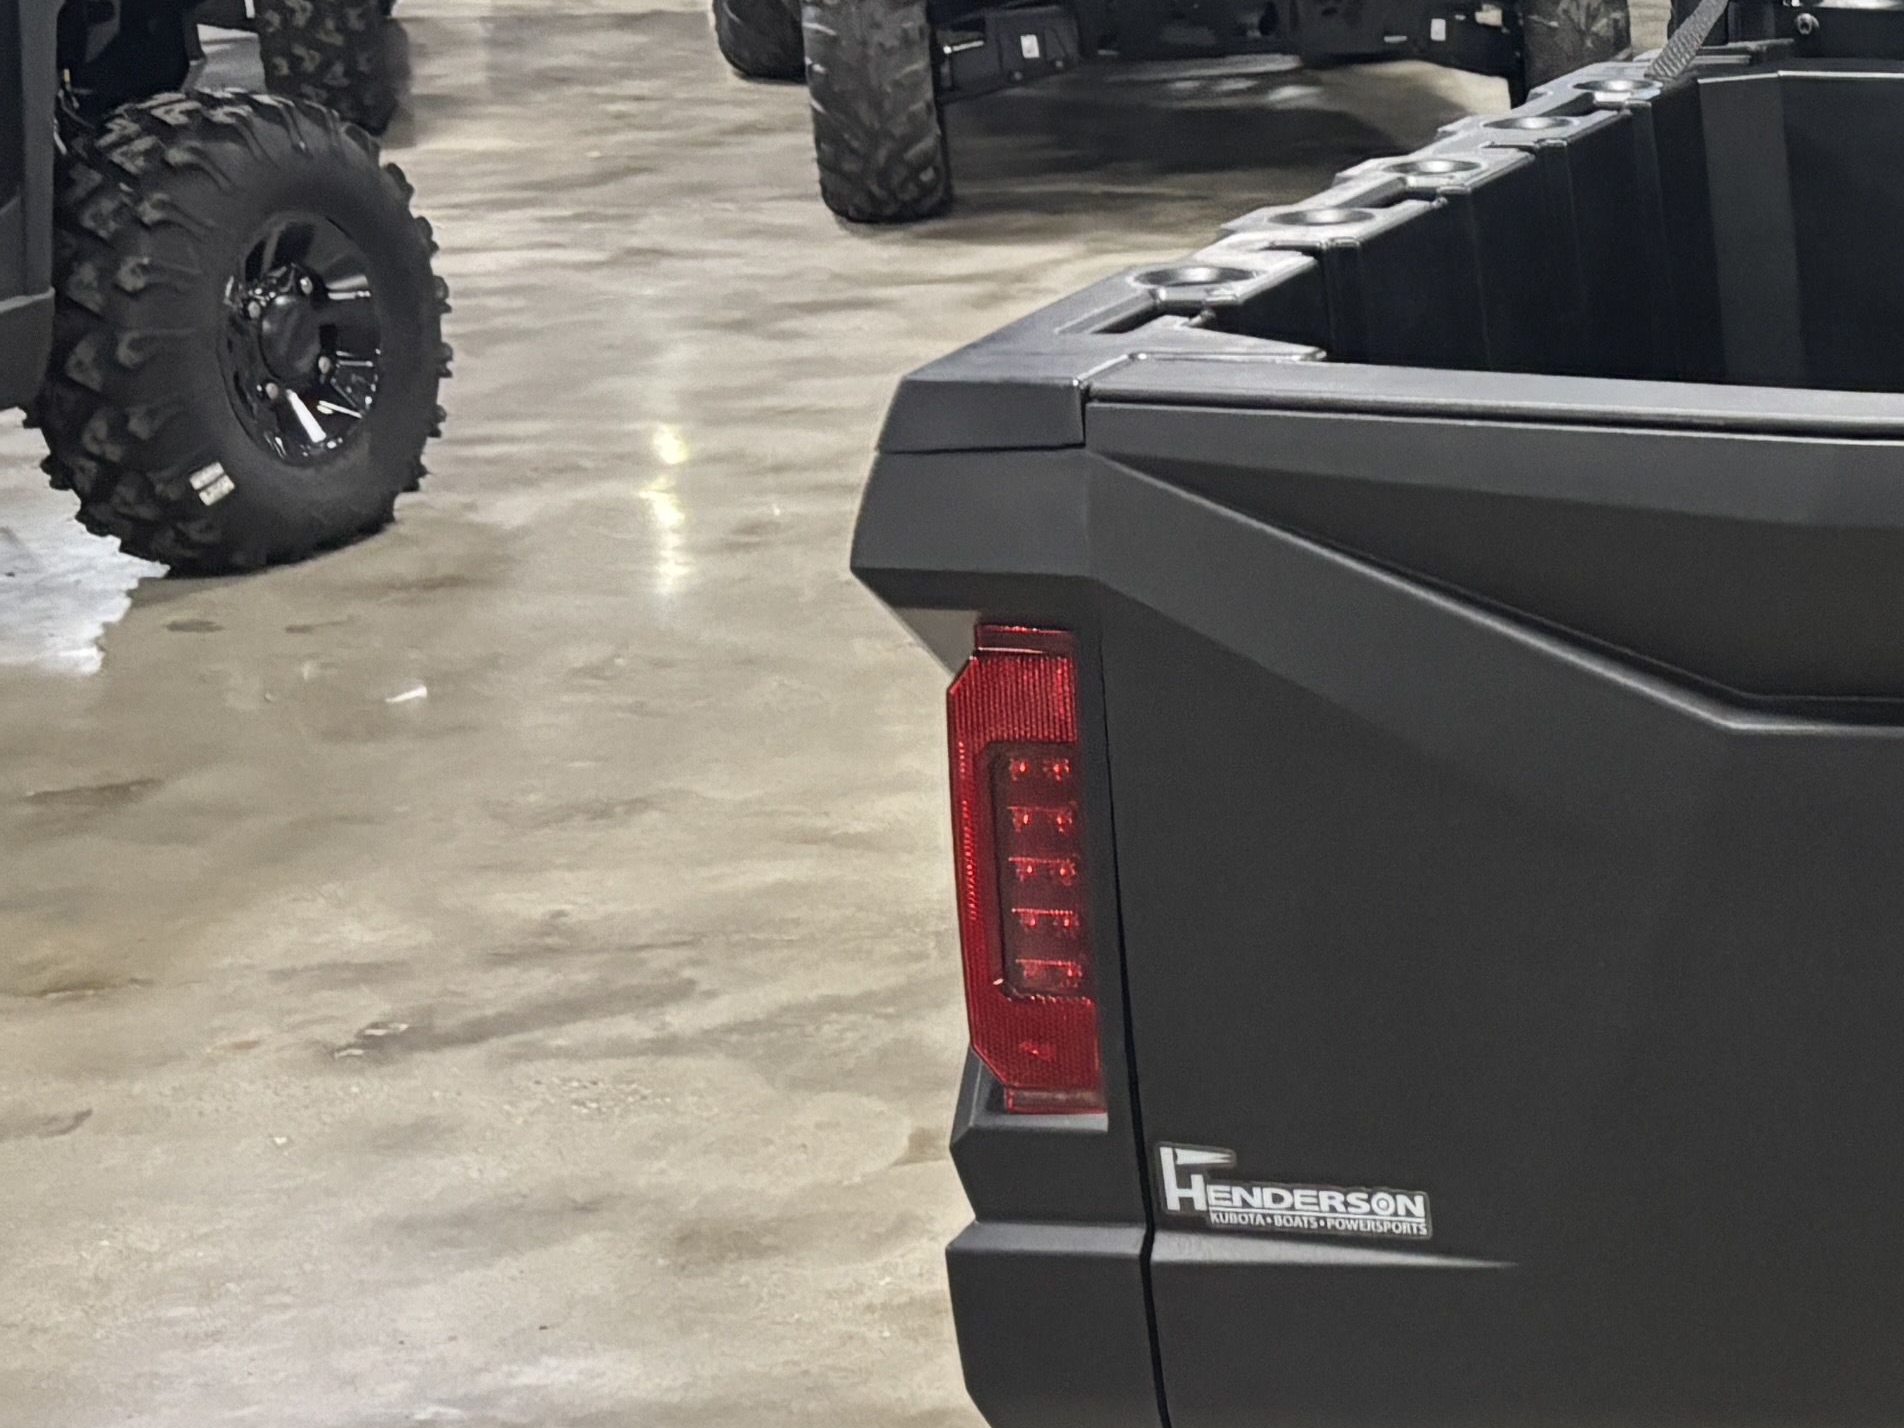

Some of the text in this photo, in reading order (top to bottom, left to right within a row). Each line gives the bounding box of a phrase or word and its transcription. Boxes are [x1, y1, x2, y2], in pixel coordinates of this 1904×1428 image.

[1159, 1146, 1426, 1217] HENDERSON
[1210, 1211, 1428, 1235] KUBOTA BOATS POWERSPORTS
